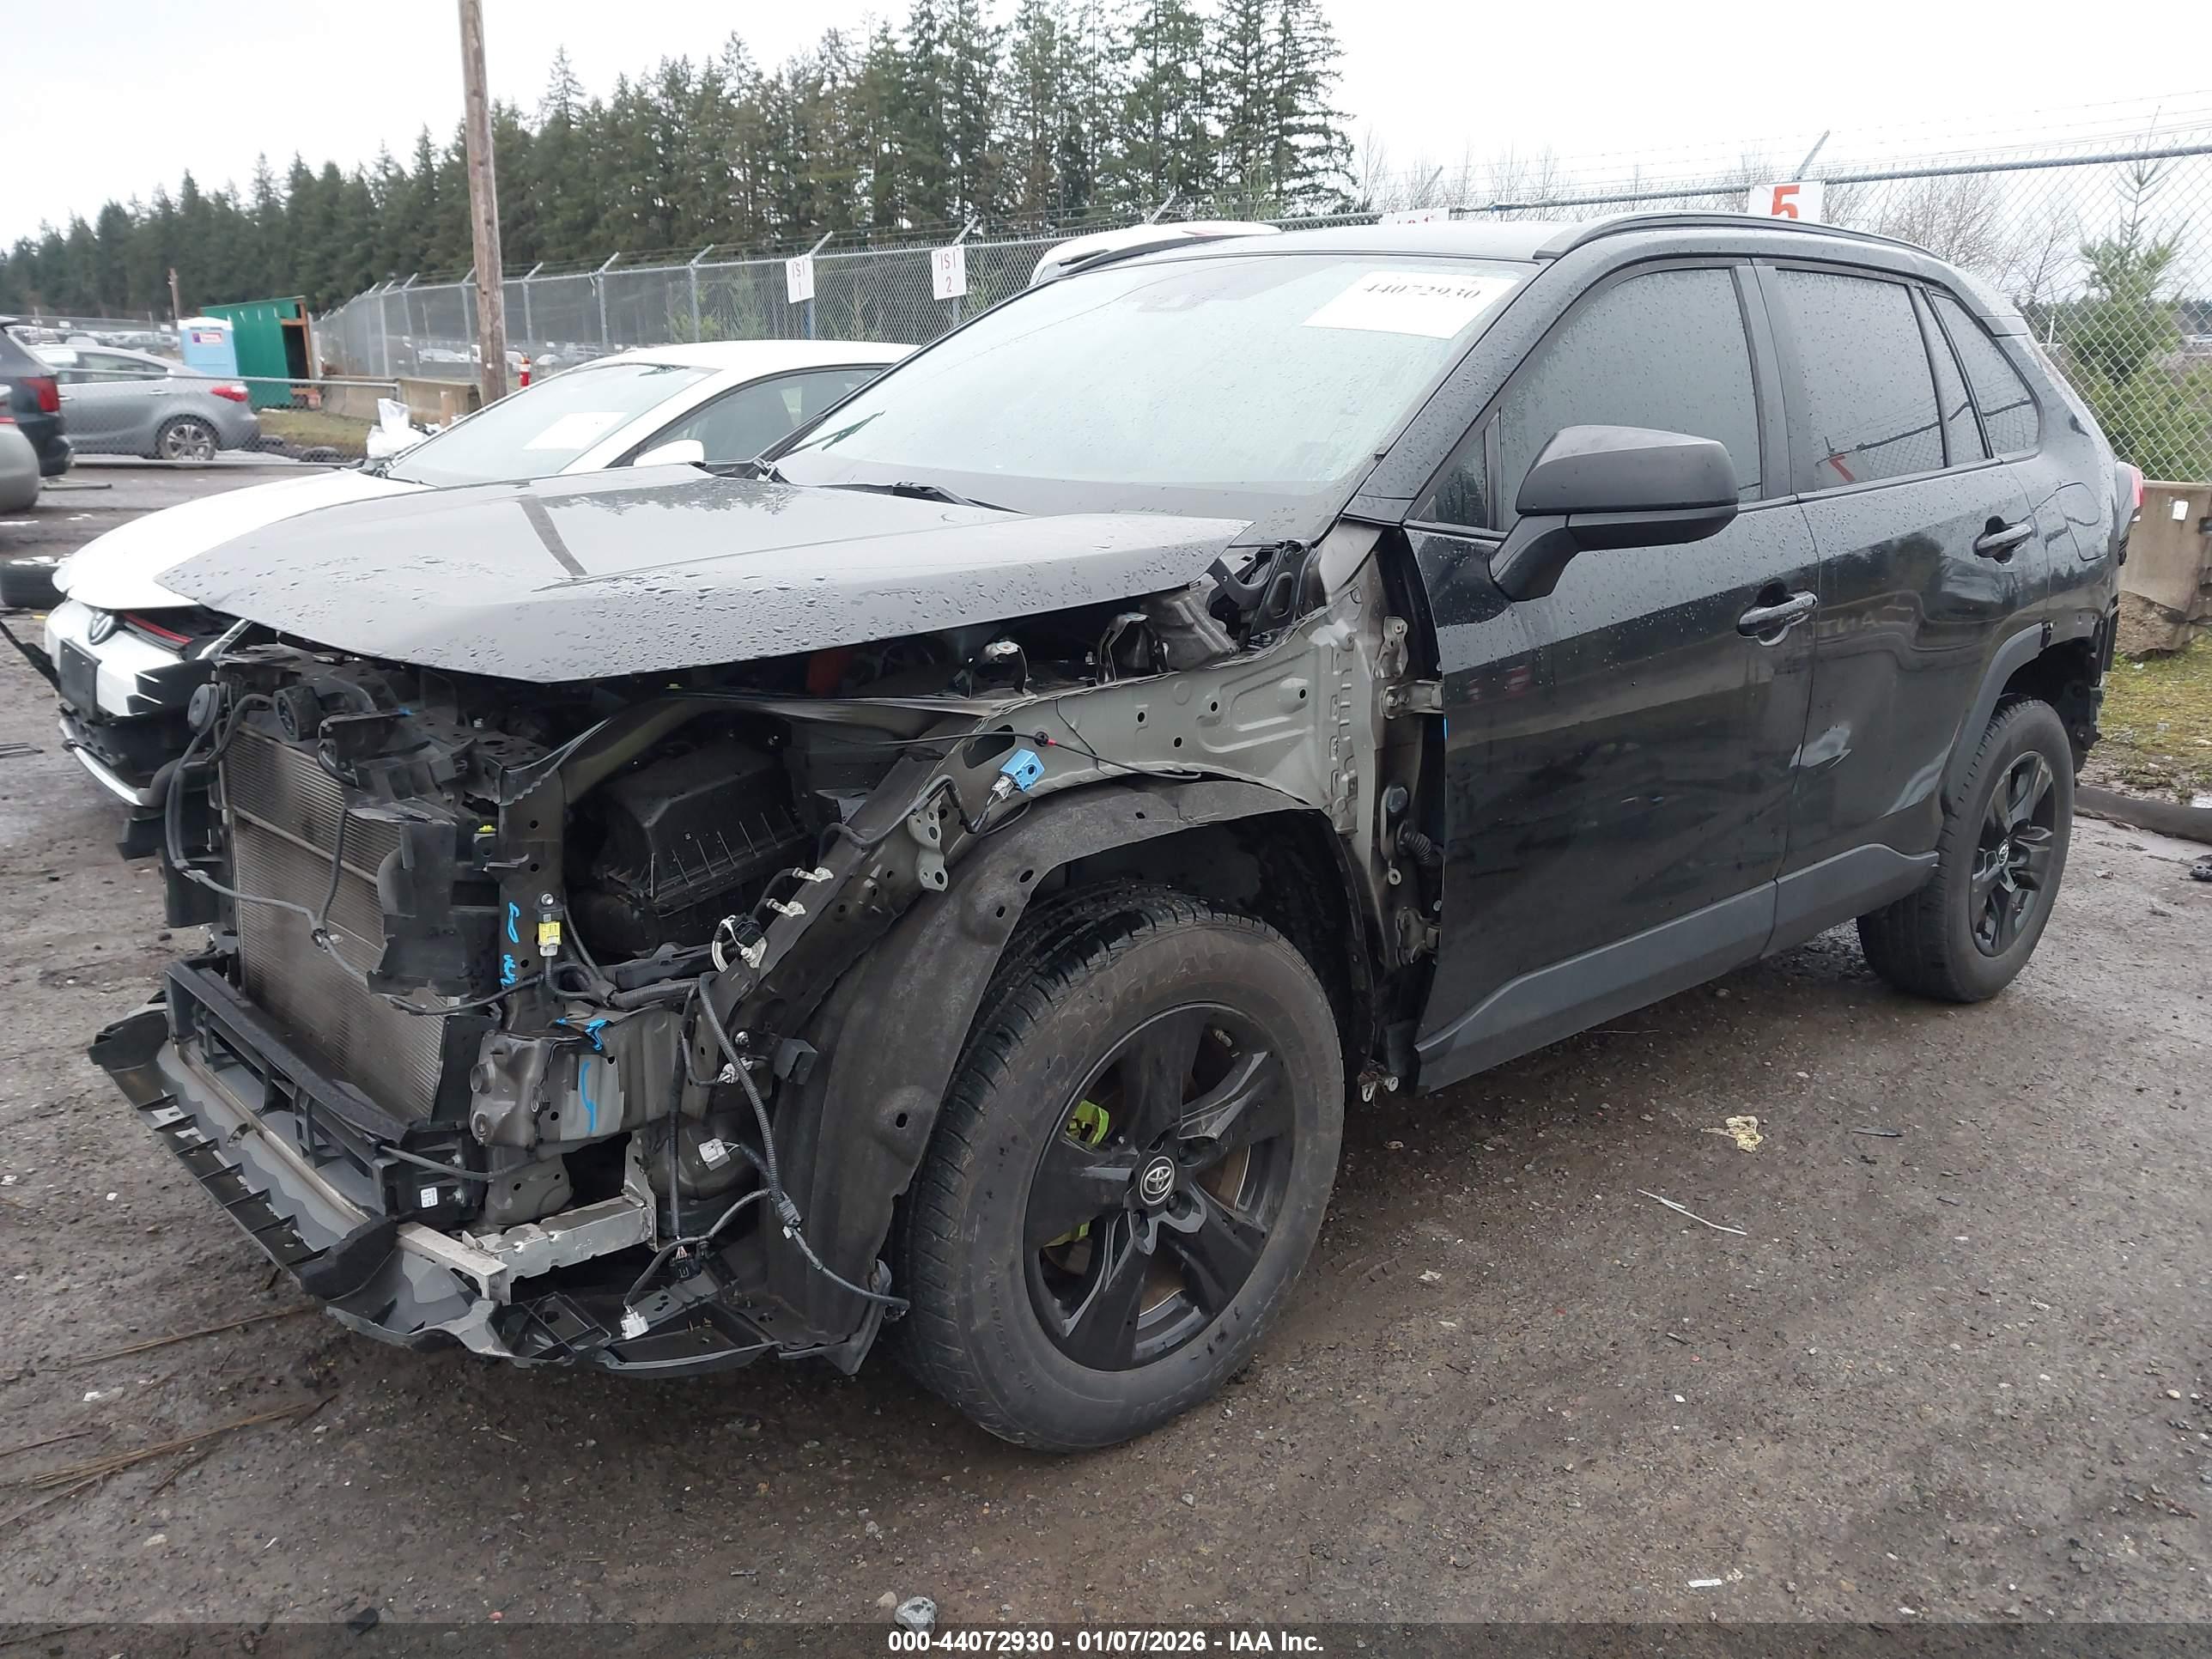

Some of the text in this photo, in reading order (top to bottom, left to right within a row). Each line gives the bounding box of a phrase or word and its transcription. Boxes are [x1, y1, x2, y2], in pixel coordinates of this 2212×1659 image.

[1771, 184, 1801, 219] 5
[945, 275, 952, 293] 2
[1363, 283, 1482, 300] 44072930
